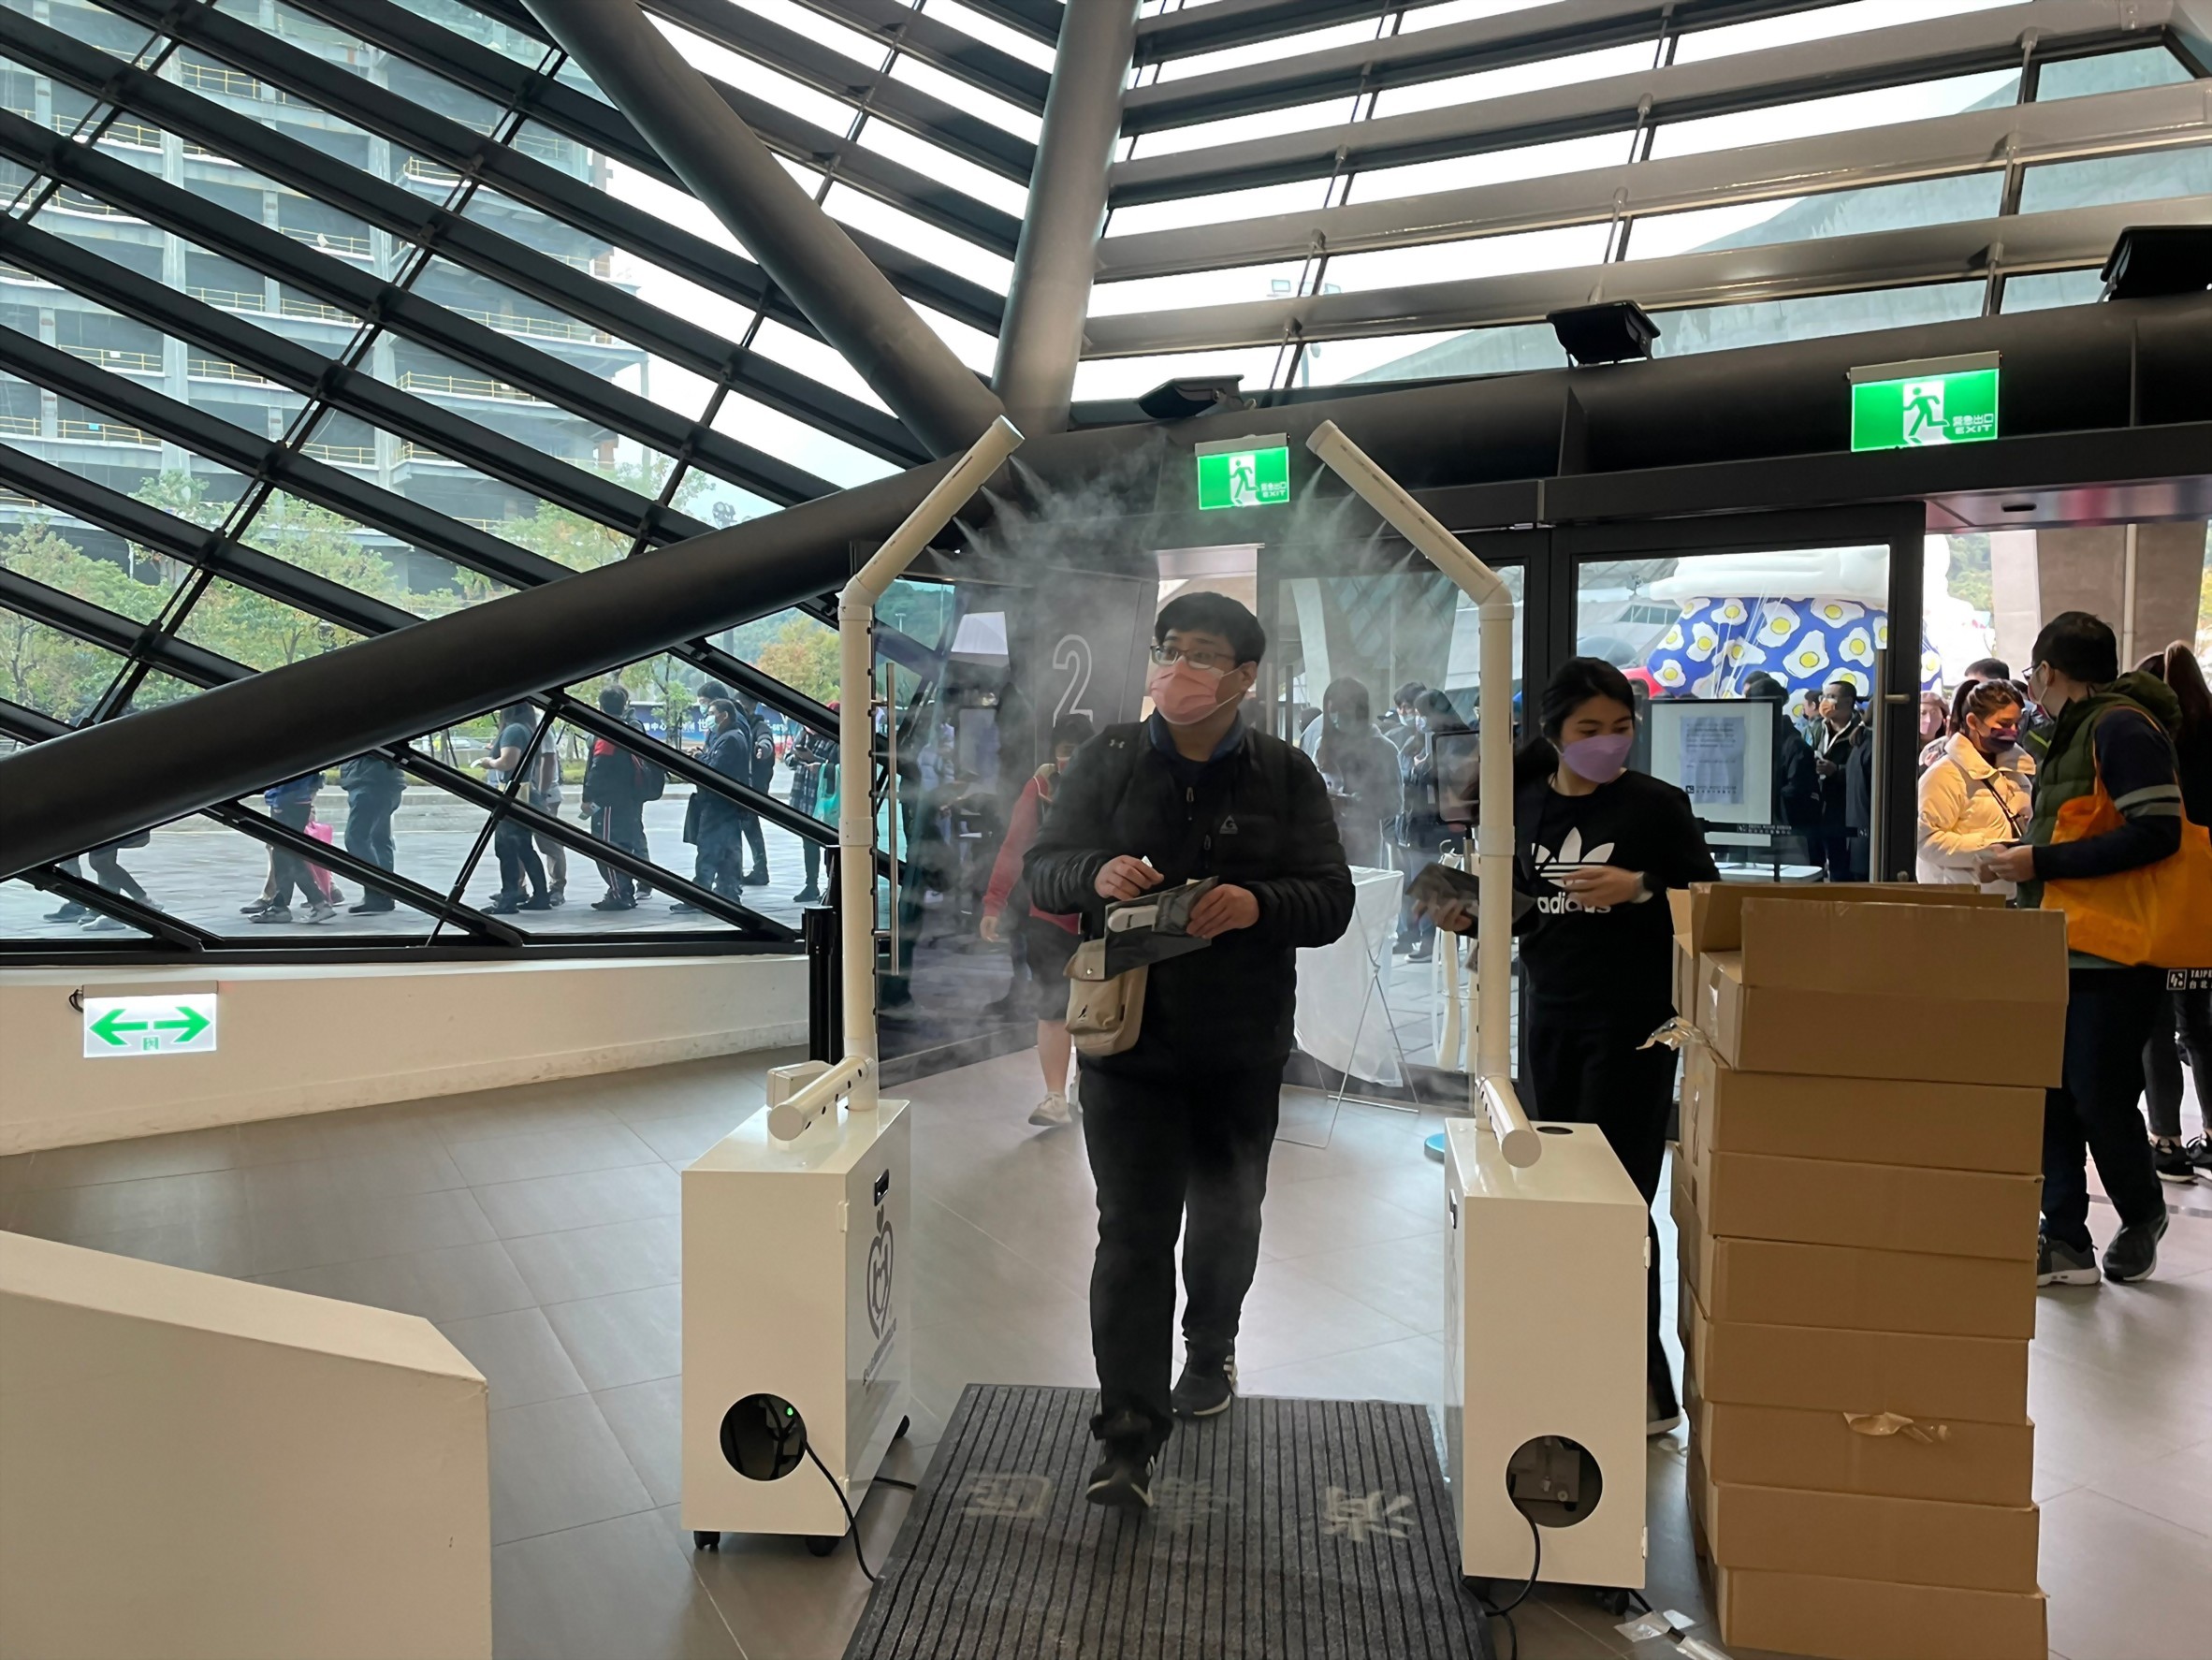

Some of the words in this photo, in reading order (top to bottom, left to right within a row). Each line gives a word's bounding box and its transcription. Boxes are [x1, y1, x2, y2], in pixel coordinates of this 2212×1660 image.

[1955, 424, 1993, 434] EXIT
[1053, 633, 1093, 728] 2
[2190, 980, 2212, 990] 台北
